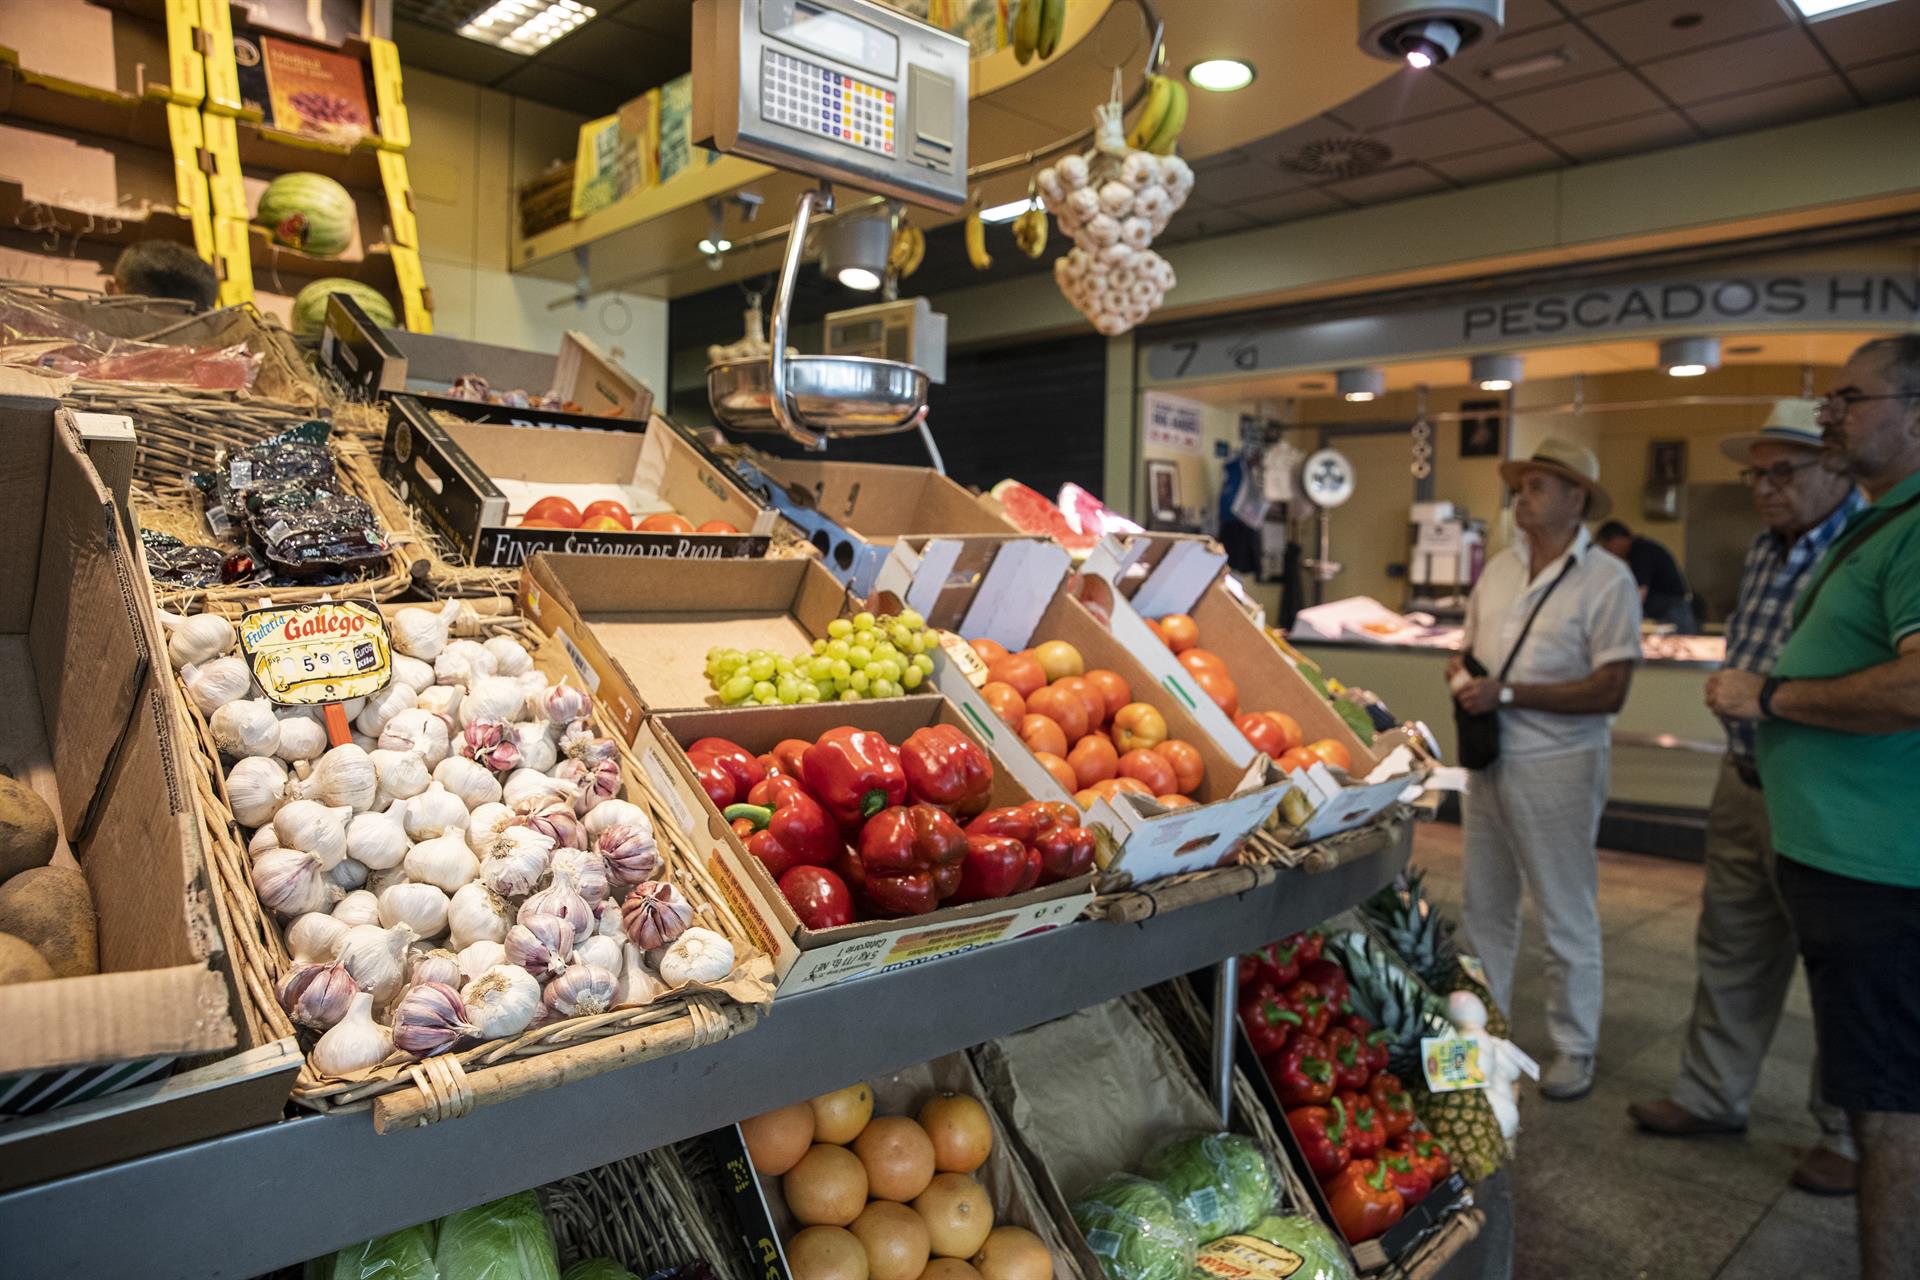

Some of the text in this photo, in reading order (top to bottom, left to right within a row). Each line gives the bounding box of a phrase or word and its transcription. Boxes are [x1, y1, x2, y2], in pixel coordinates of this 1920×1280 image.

[1463, 277, 1807, 340] PESCADOS
[1171, 341, 1198, 378] 7
[284, 614, 365, 641] Gallego
